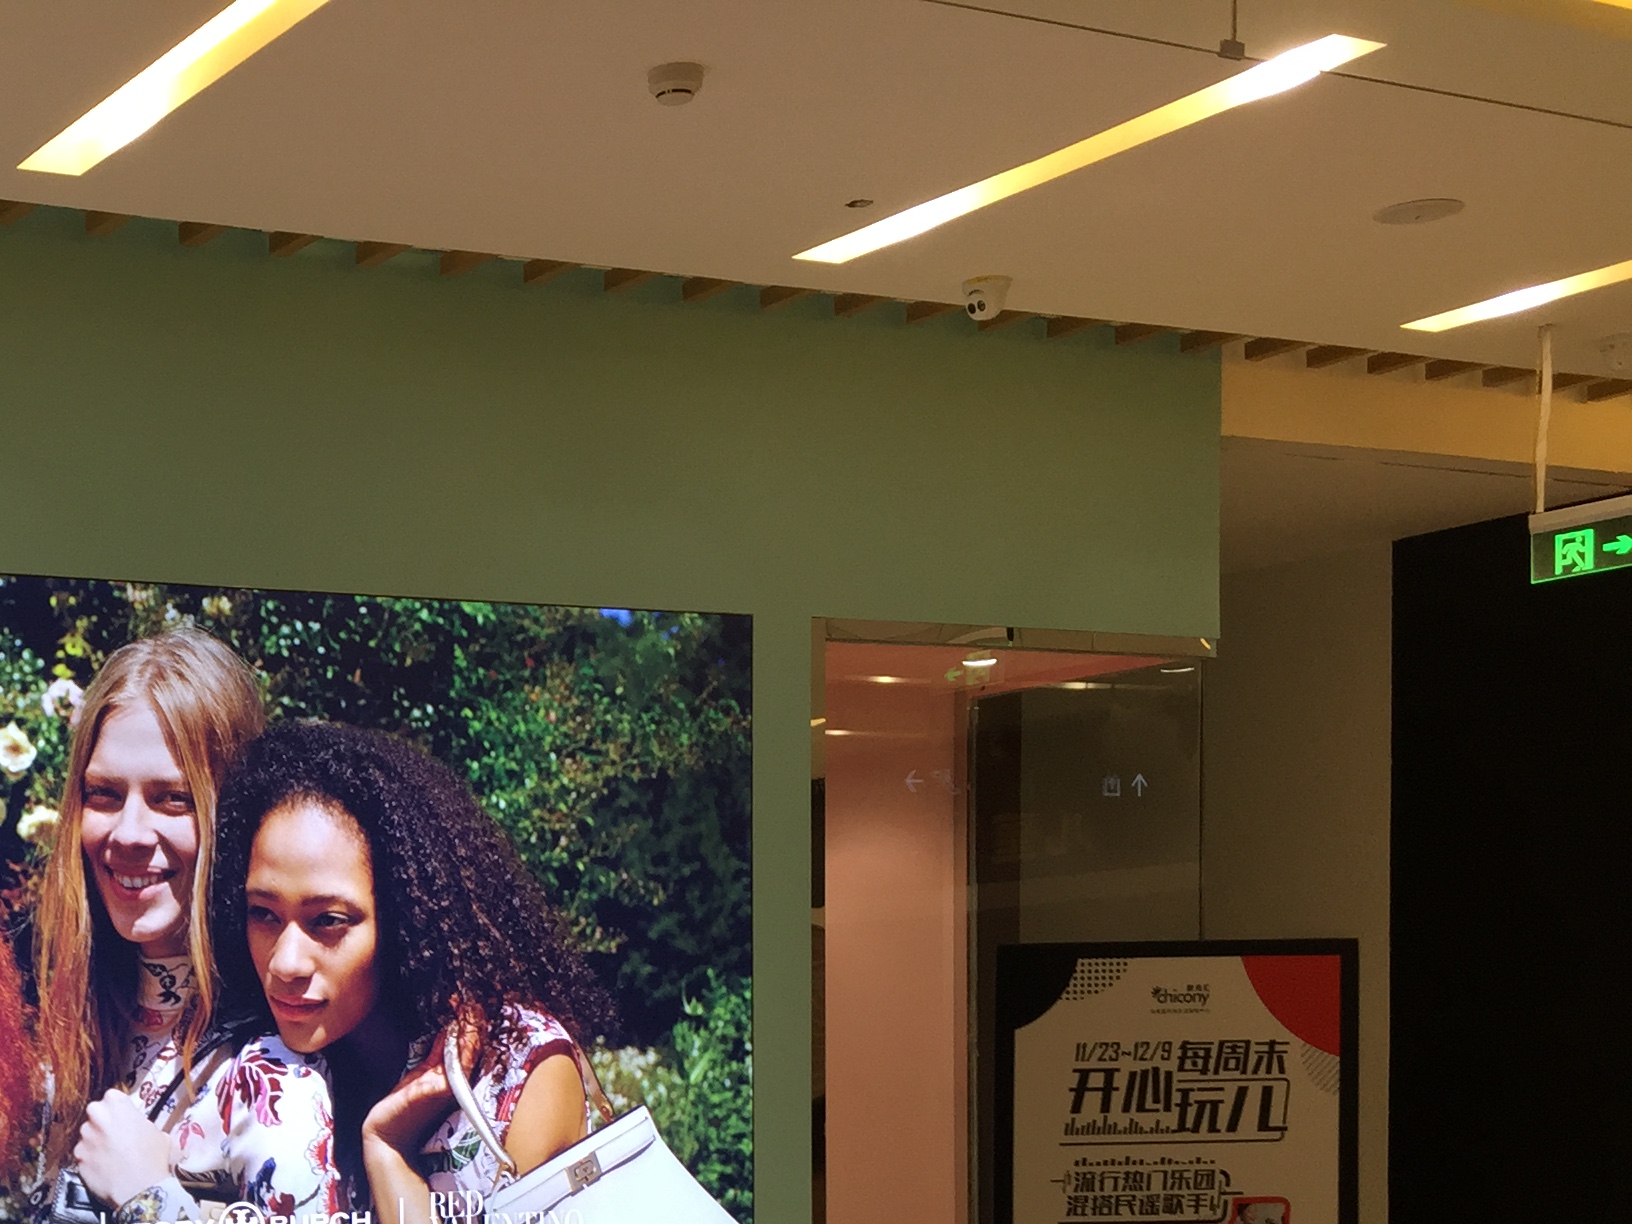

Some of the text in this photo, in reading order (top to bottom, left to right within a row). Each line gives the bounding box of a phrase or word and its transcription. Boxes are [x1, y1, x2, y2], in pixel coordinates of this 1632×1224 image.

[1177, 1039, 1290, 1076] 每周末
[1068, 1066, 1288, 1135] 开心玩儿
[1073, 1168, 1216, 1193] 流行热门乐团
[428, 1189, 483, 1219] RED
[1066, 1194, 1208, 1217] 混搭民谣歌手
